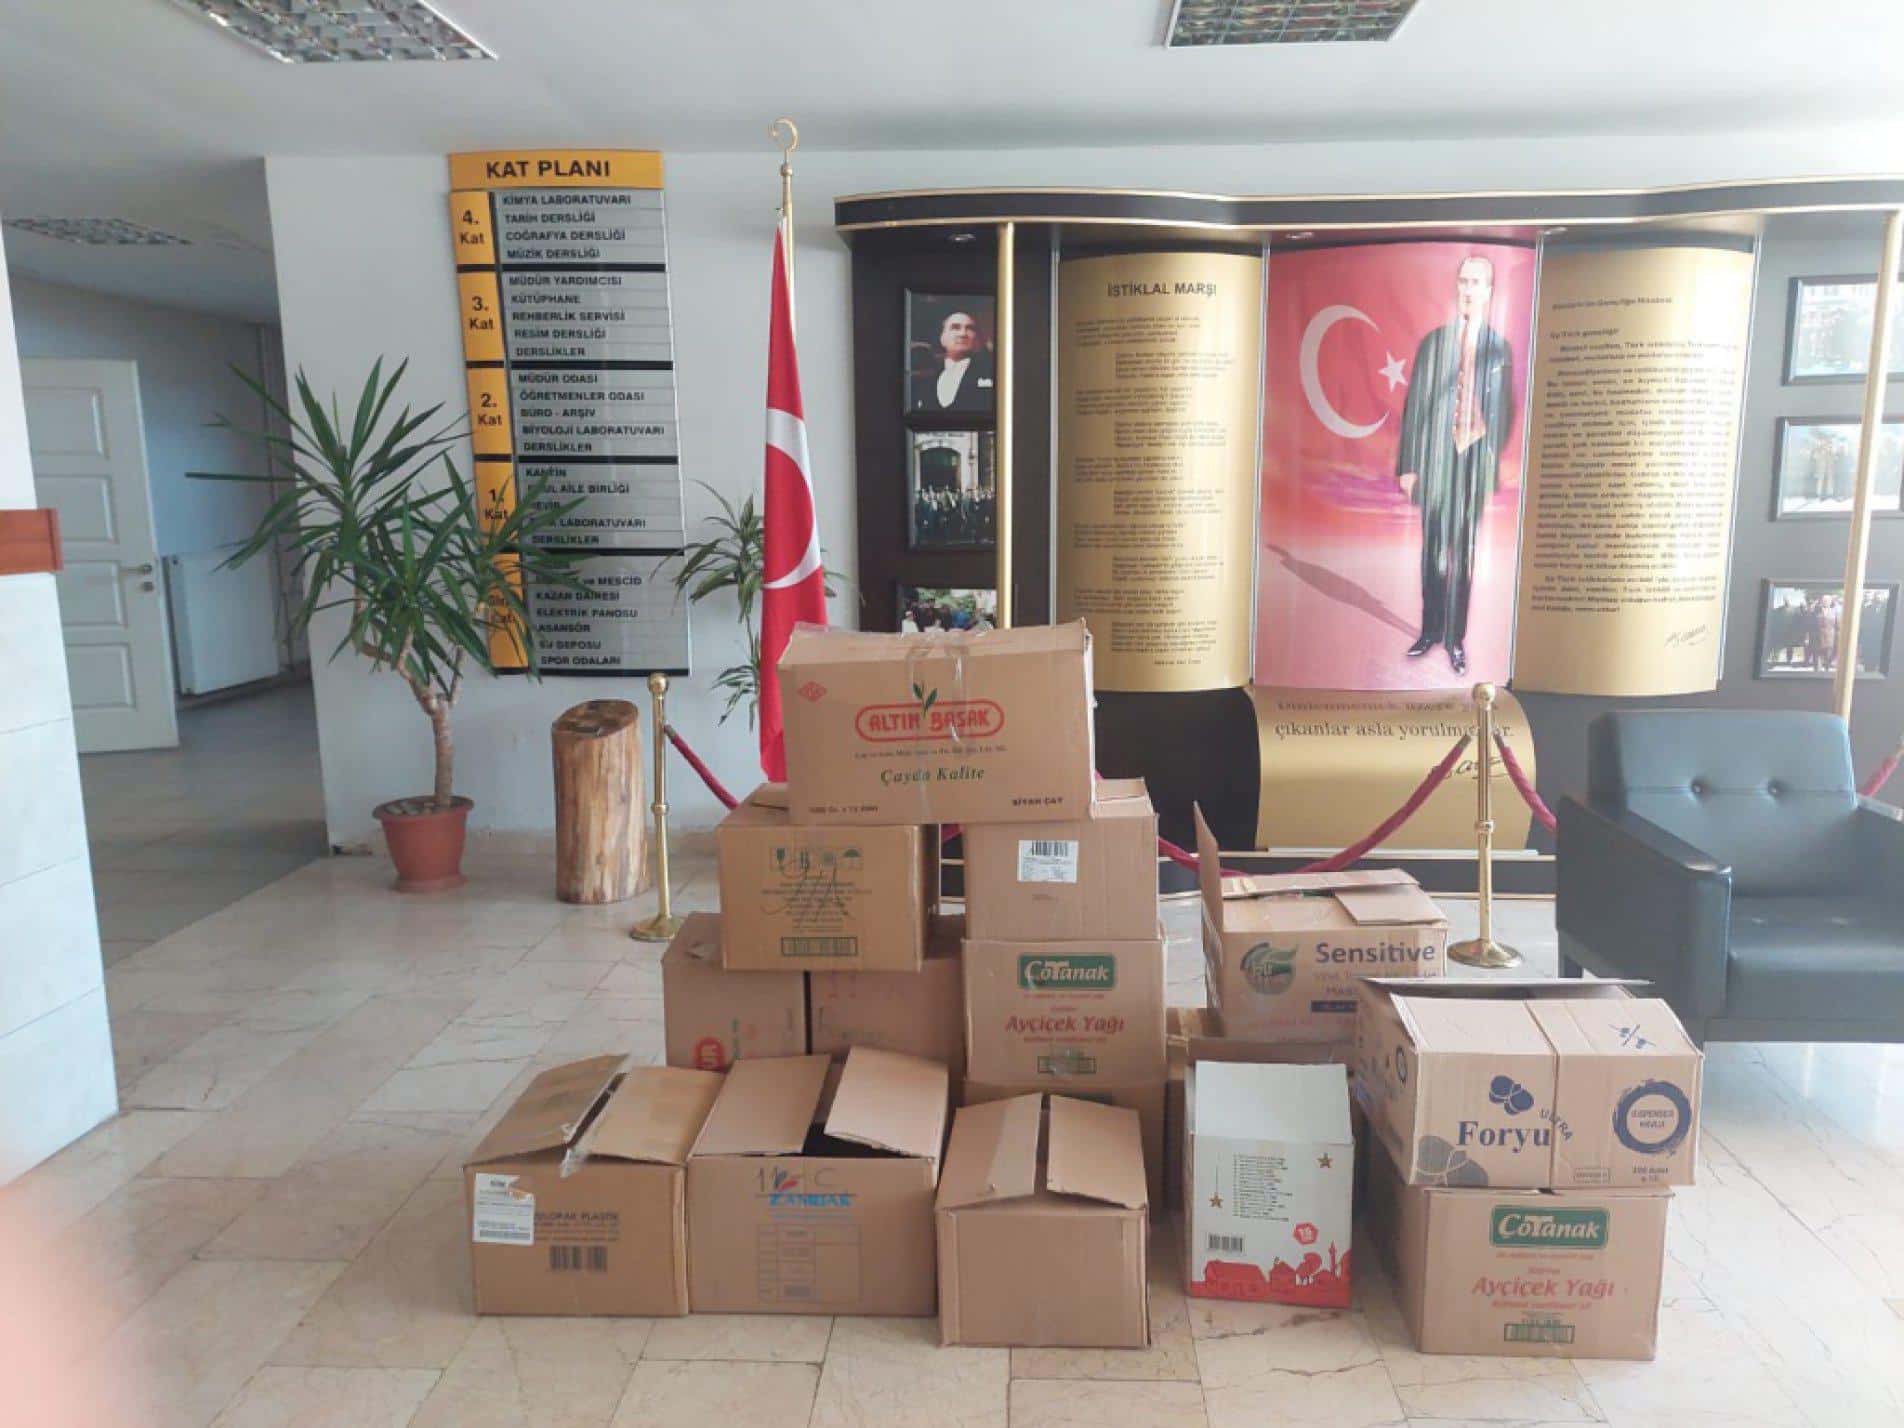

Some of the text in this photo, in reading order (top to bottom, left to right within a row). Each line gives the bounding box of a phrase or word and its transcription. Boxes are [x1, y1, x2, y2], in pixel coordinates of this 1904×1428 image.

[487, 160, 610, 179] KAT PLANI
[503, 194, 631, 206] KİMYA LABORATUVARI
[462, 210, 480, 225] 4.
[505, 213, 538, 223] TARİH
[460, 232, 485, 244] Kat
[506, 229, 567, 241] COĞRAFYA
[507, 247, 543, 259] MÜZİK
[509, 275, 622, 286] MÜDÜR YARDIMCISI
[1107, 282, 1217, 297] İSTİKLAL MARŞI
[471, 296, 489, 311] 3.
[511, 293, 580, 304] KÜTÜPHANE
[512, 310, 575, 321] REHBERLİK
[469, 317, 494, 330] Kat
[518, 373, 598, 384] MÜDÜR ODASI
[480, 393, 497, 407] 2.
[519, 389, 644, 401] ÖĞRETMENLER ODASI
[477, 414, 502, 426] Kat
[576, 425, 665, 435] LABORATUVARI
[560, 518, 646, 528] LABORATUVARI
[592, 609, 638, 618] PANOSU
[556, 640, 602, 650] DEPOSU
[541, 655, 569, 665] SPOR
[1275, 720, 1351, 740] çıkanlar
[1356, 721, 1393, 737] asla
[936, 765, 985, 781] Kalite
[1315, 942, 1435, 964] Sensitive
[1457, 1121, 1551, 1154] Foryu
